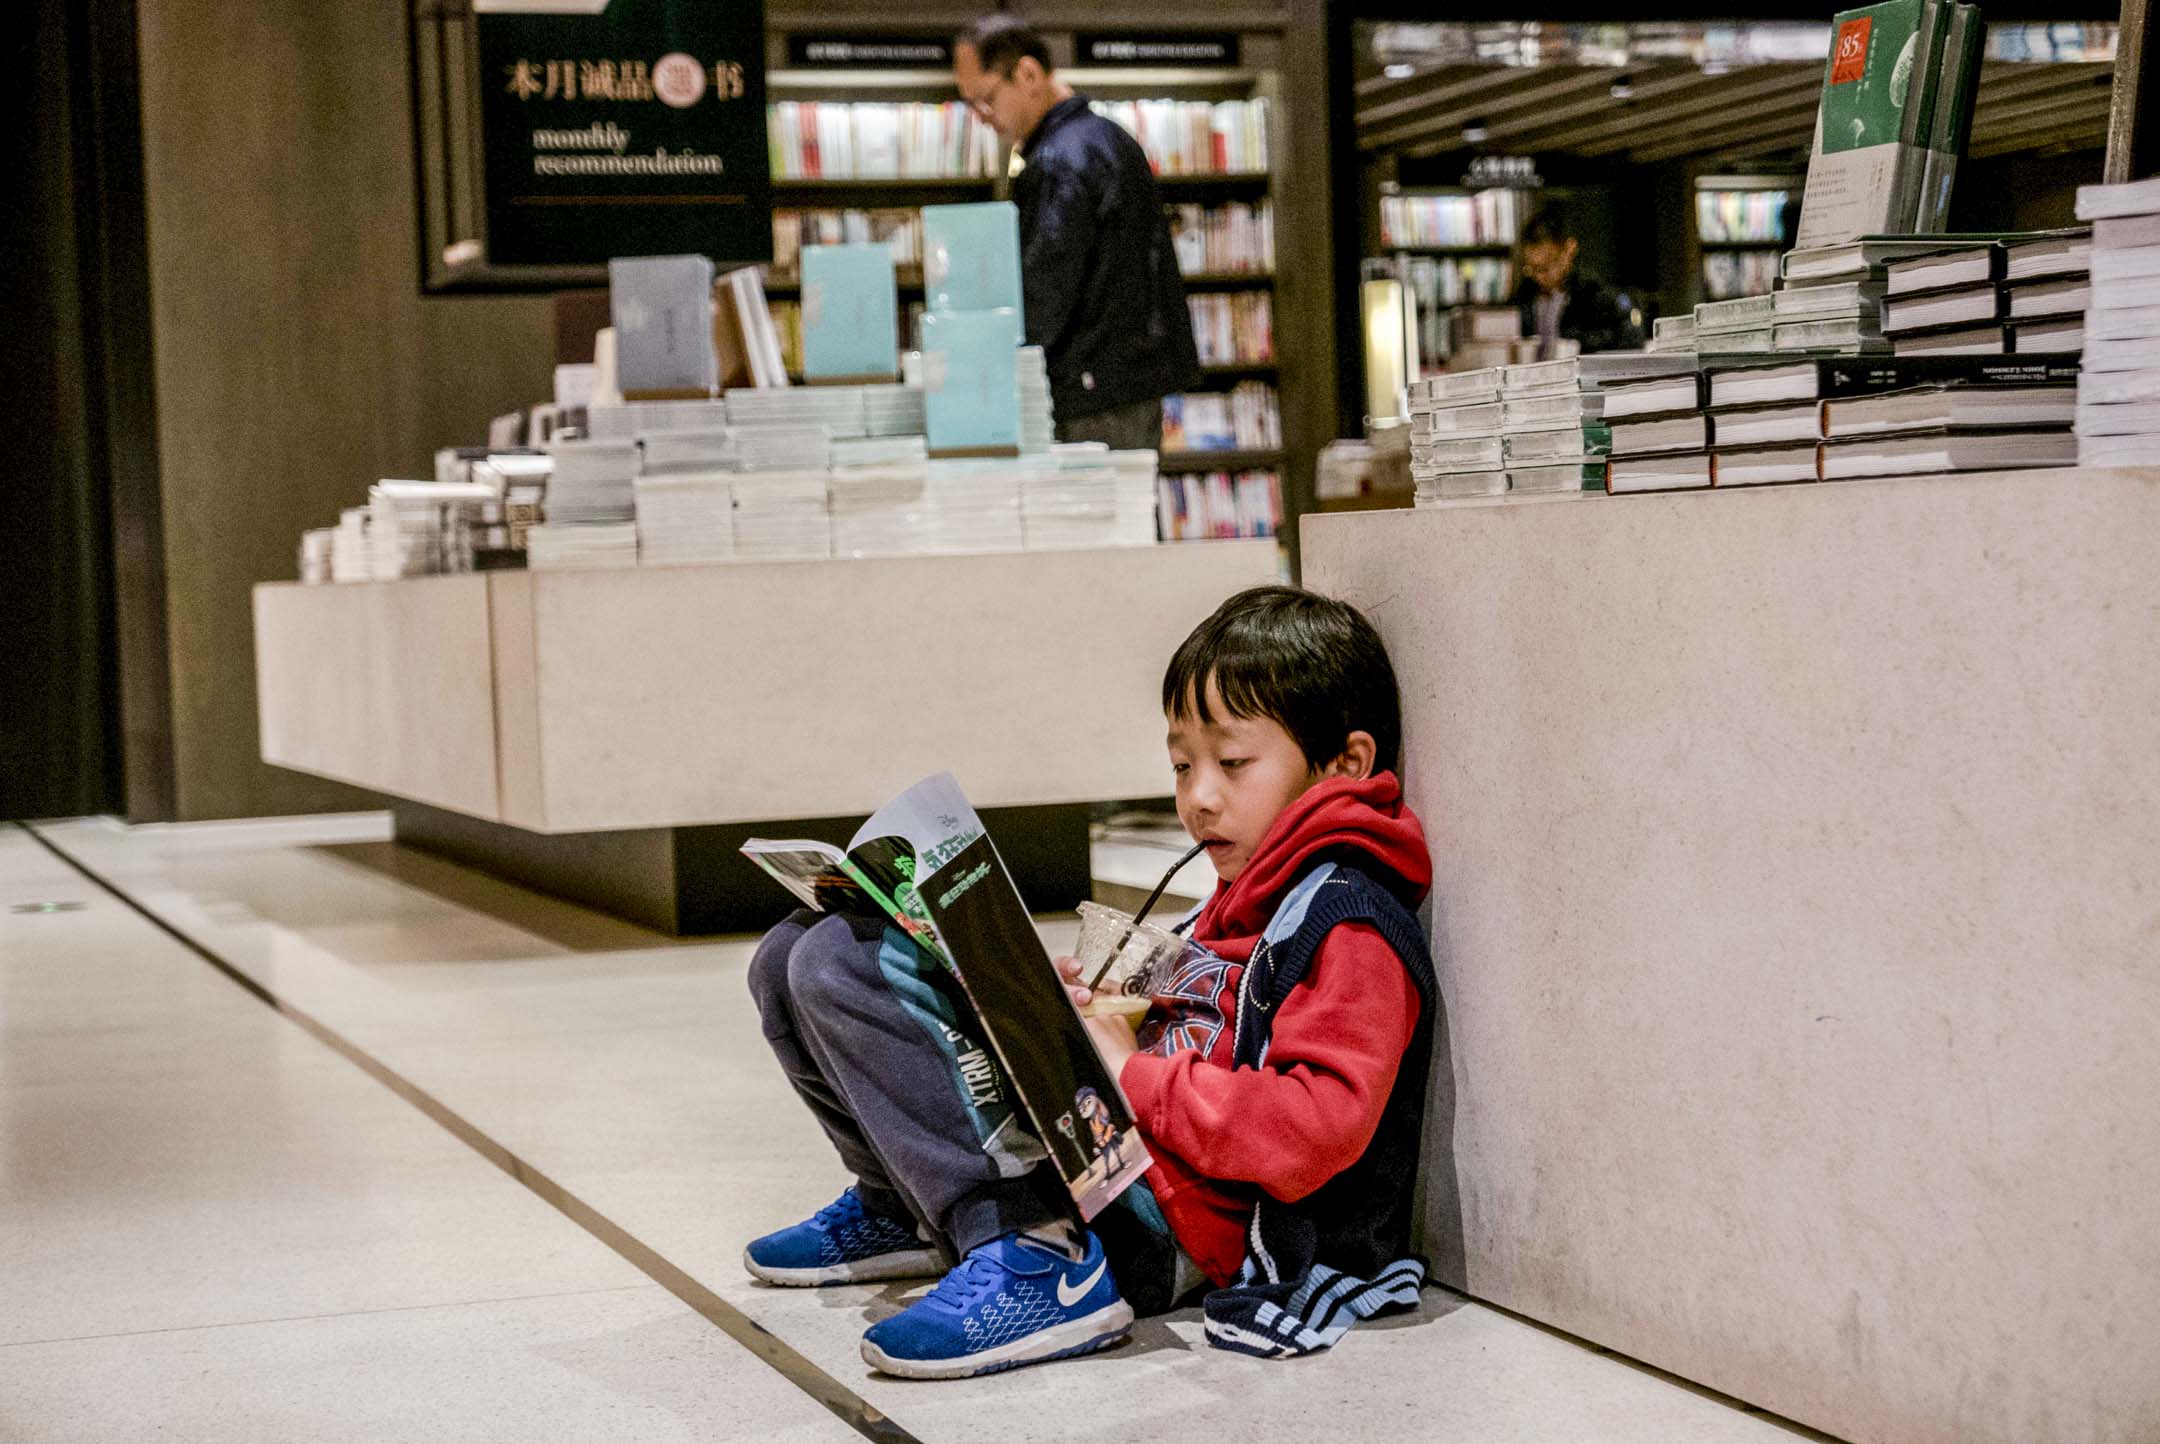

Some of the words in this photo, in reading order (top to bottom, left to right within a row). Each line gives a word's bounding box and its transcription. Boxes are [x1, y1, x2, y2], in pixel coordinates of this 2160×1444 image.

[533, 121, 631, 153] monthly
[533, 148, 724, 174] recommendation
[957, 1048, 999, 1107] XTRM
